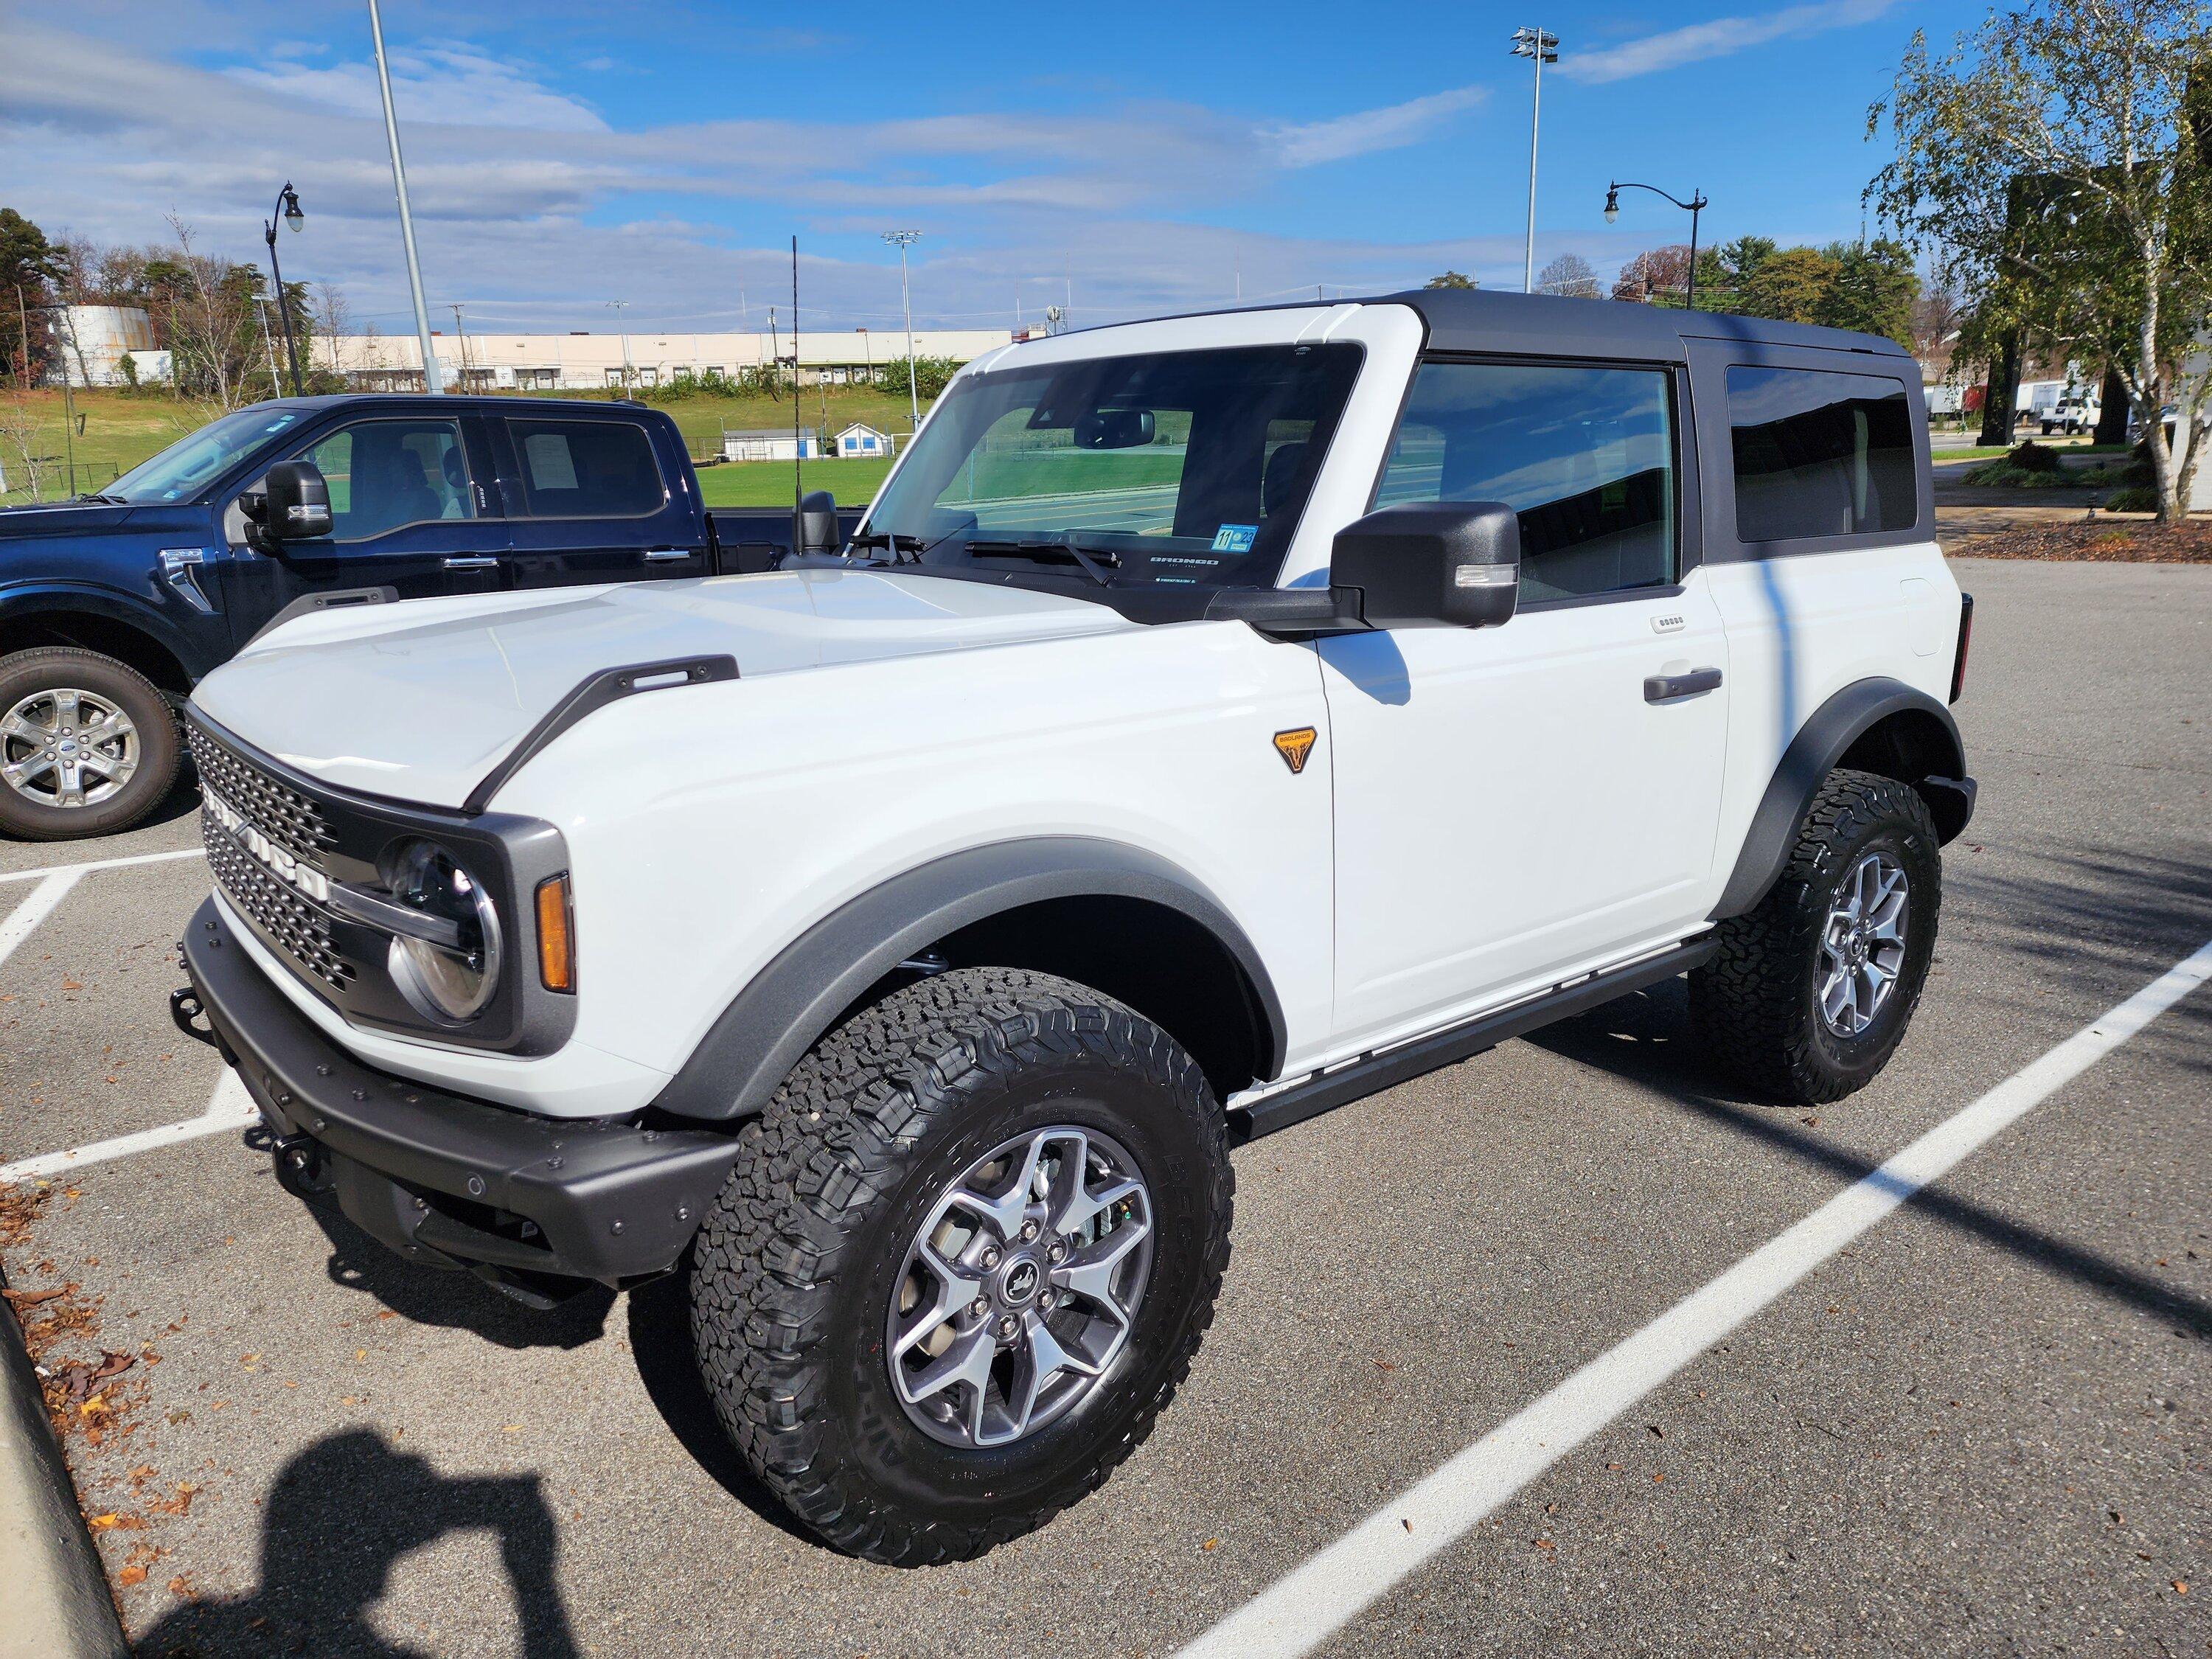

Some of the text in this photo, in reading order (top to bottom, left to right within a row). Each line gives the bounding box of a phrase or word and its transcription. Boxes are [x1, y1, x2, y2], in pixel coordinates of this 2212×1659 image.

[1218, 531, 1254, 546] 11 23
[1150, 557, 1219, 566] BRONCO
[1279, 733, 1310, 742] BADLANDS
[202, 782, 328, 901] BRONCO
